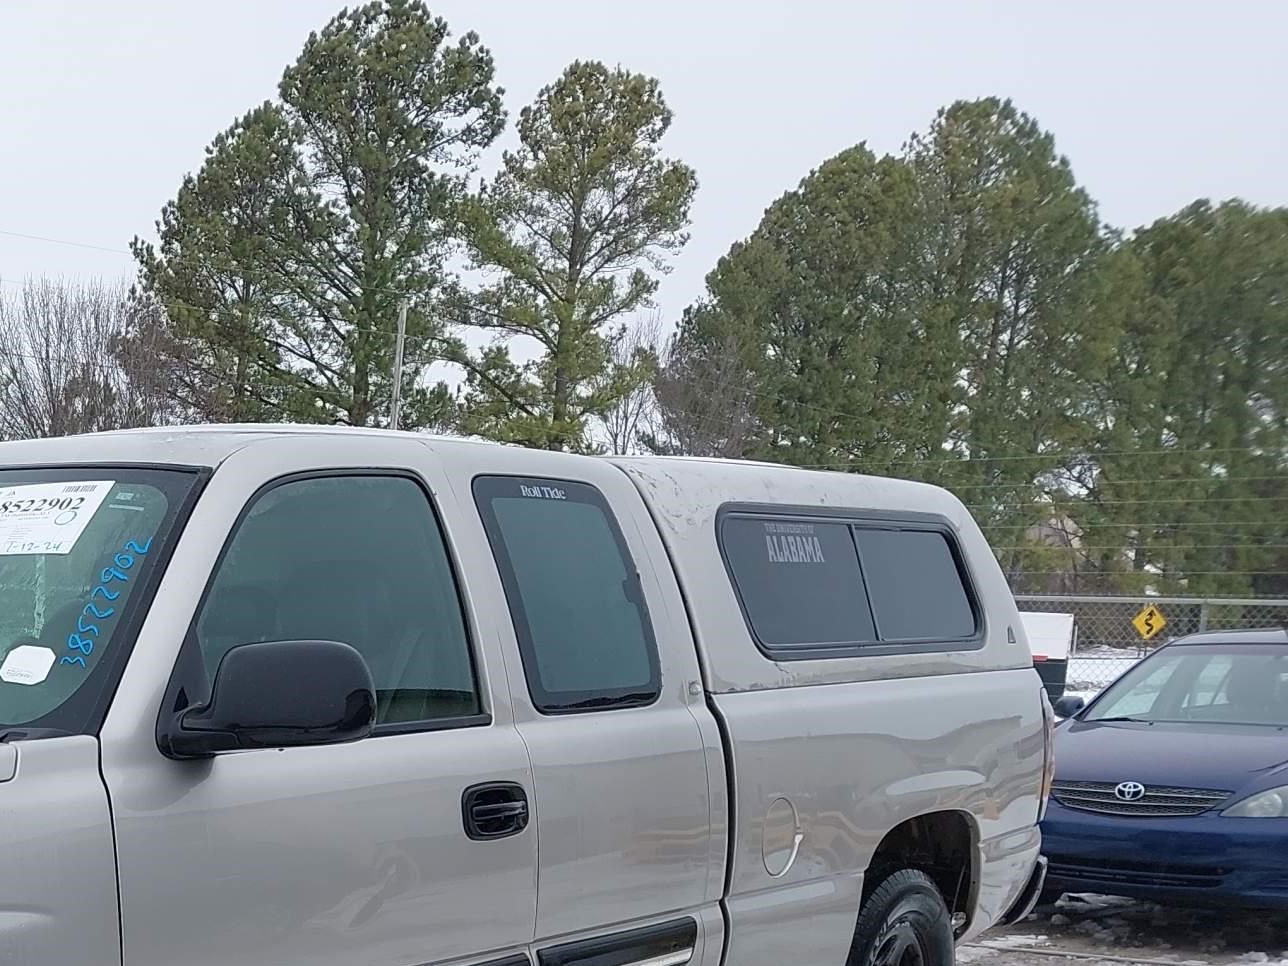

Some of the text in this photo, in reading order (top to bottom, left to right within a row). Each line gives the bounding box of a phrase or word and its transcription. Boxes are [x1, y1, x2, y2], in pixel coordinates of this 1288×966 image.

[520, 485, 567, 499] Roll Tide
[765, 535, 825, 563] ALABAMA
[59, 536, 153, 668] 38522902
